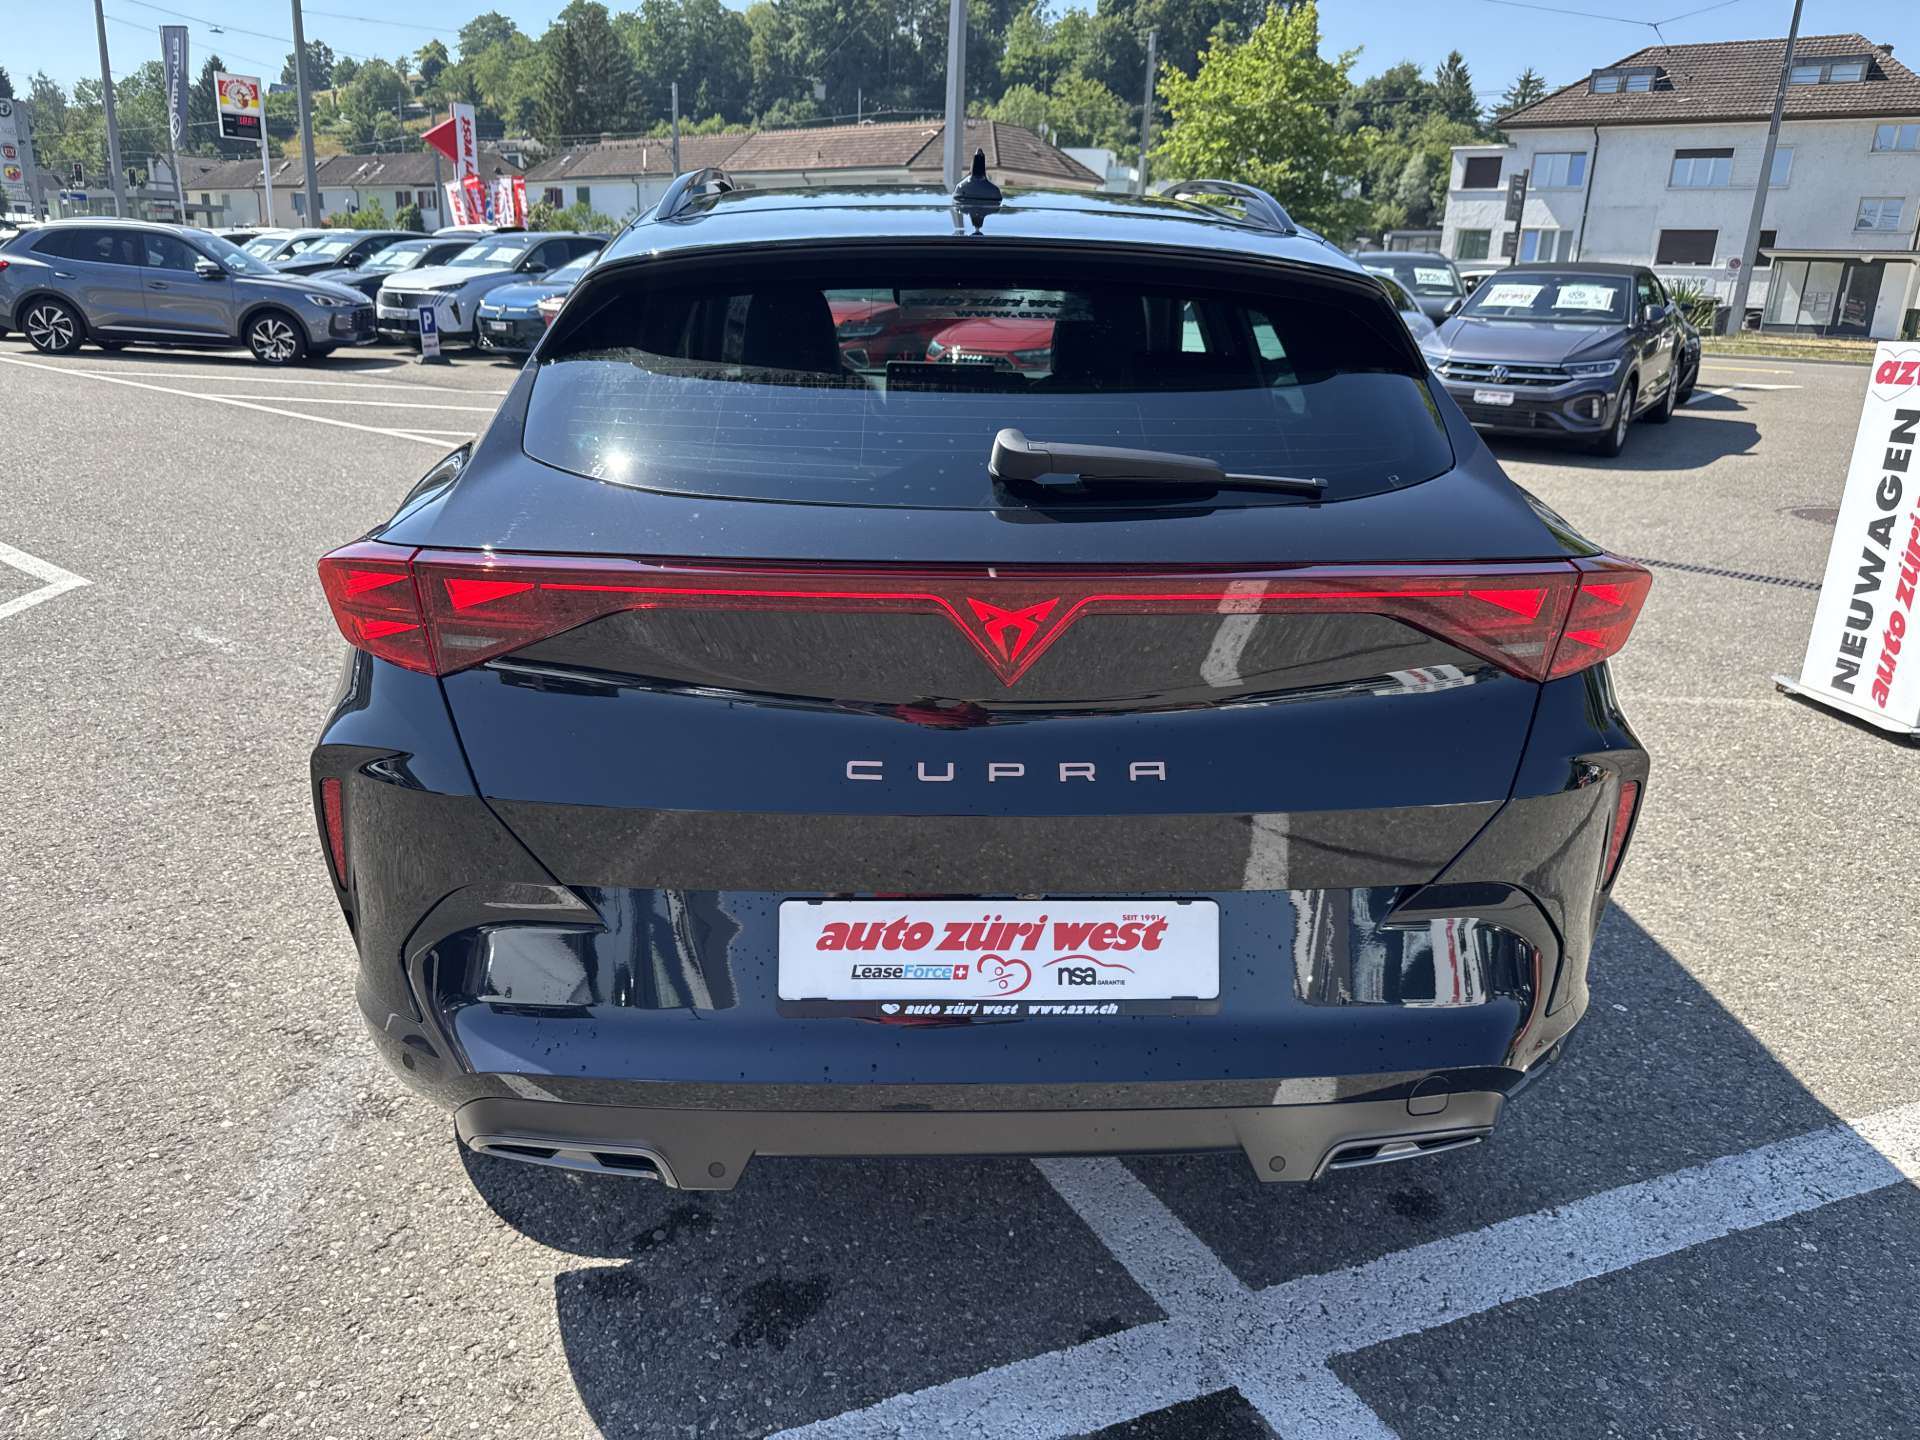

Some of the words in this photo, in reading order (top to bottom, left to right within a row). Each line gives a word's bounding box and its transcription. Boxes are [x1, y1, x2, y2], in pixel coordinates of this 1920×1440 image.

[422, 310, 432, 331] P
[1875, 360, 1920, 386] az
[1831, 408, 1920, 695] NEUWAGEN
[1871, 610, 1906, 709] auto
[846, 760, 1167, 783] CUPRA
[815, 914, 935, 951] auto
[934, 914, 1049, 951] züri
[1053, 915, 1169, 951] west
[851, 964, 953, 979] LeaseForce
[1057, 966, 1097, 986] nsa
[904, 1004, 940, 1015] auto
[943, 1003, 979, 1015] züri
[982, 1004, 1019, 1015] west
[1028, 1003, 1119, 1015] www.azw.ch
